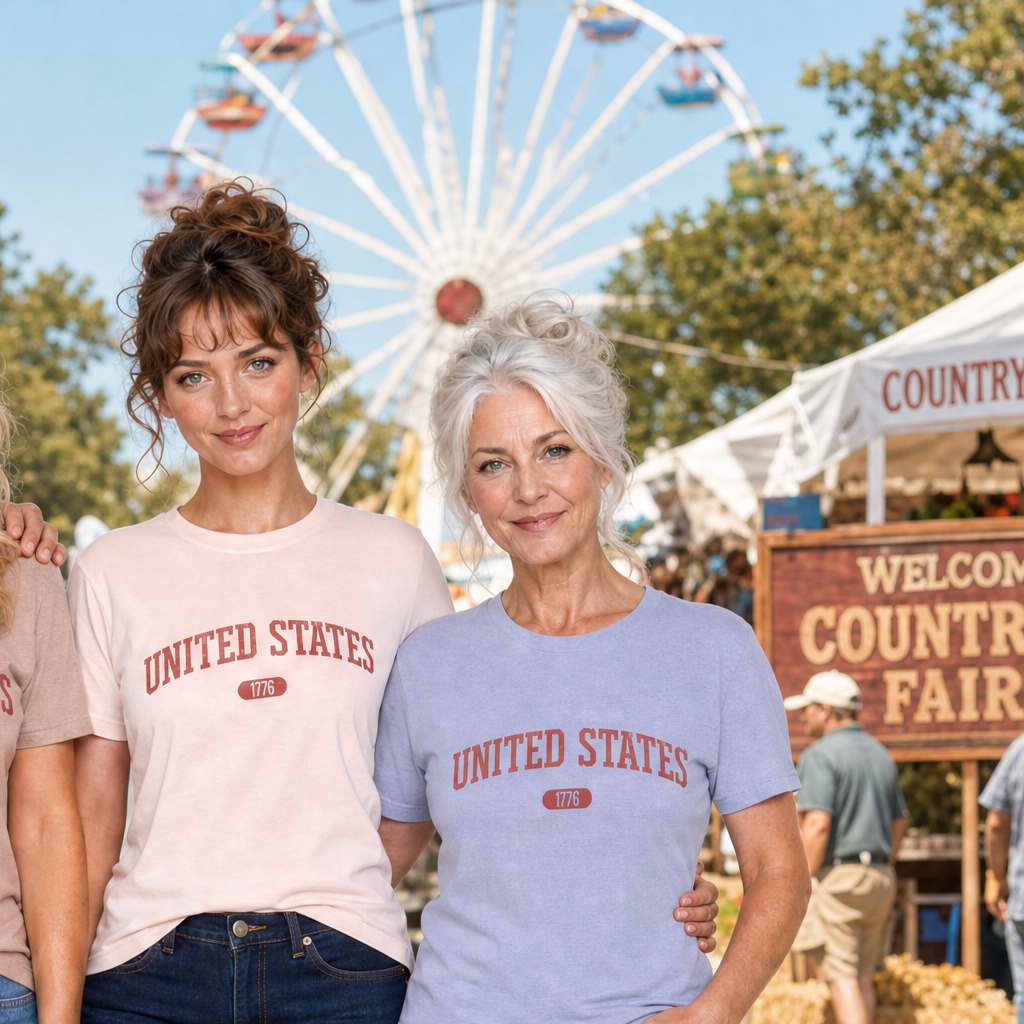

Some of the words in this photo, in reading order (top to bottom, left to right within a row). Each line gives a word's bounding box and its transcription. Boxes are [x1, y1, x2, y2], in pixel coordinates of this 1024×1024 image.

[882, 357, 1024, 413] COUNTRY
[144, 622, 257, 696] UNITED
[269, 619, 375, 675] STATES
[799, 600, 1024, 666] COUNTR
[250, 680, 275, 698] 1776
[882, 665, 1024, 726] FAIR
[453, 728, 565, 791] UNITED
[578, 727, 689, 788] STATES
[555, 790, 580, 808] 1776
